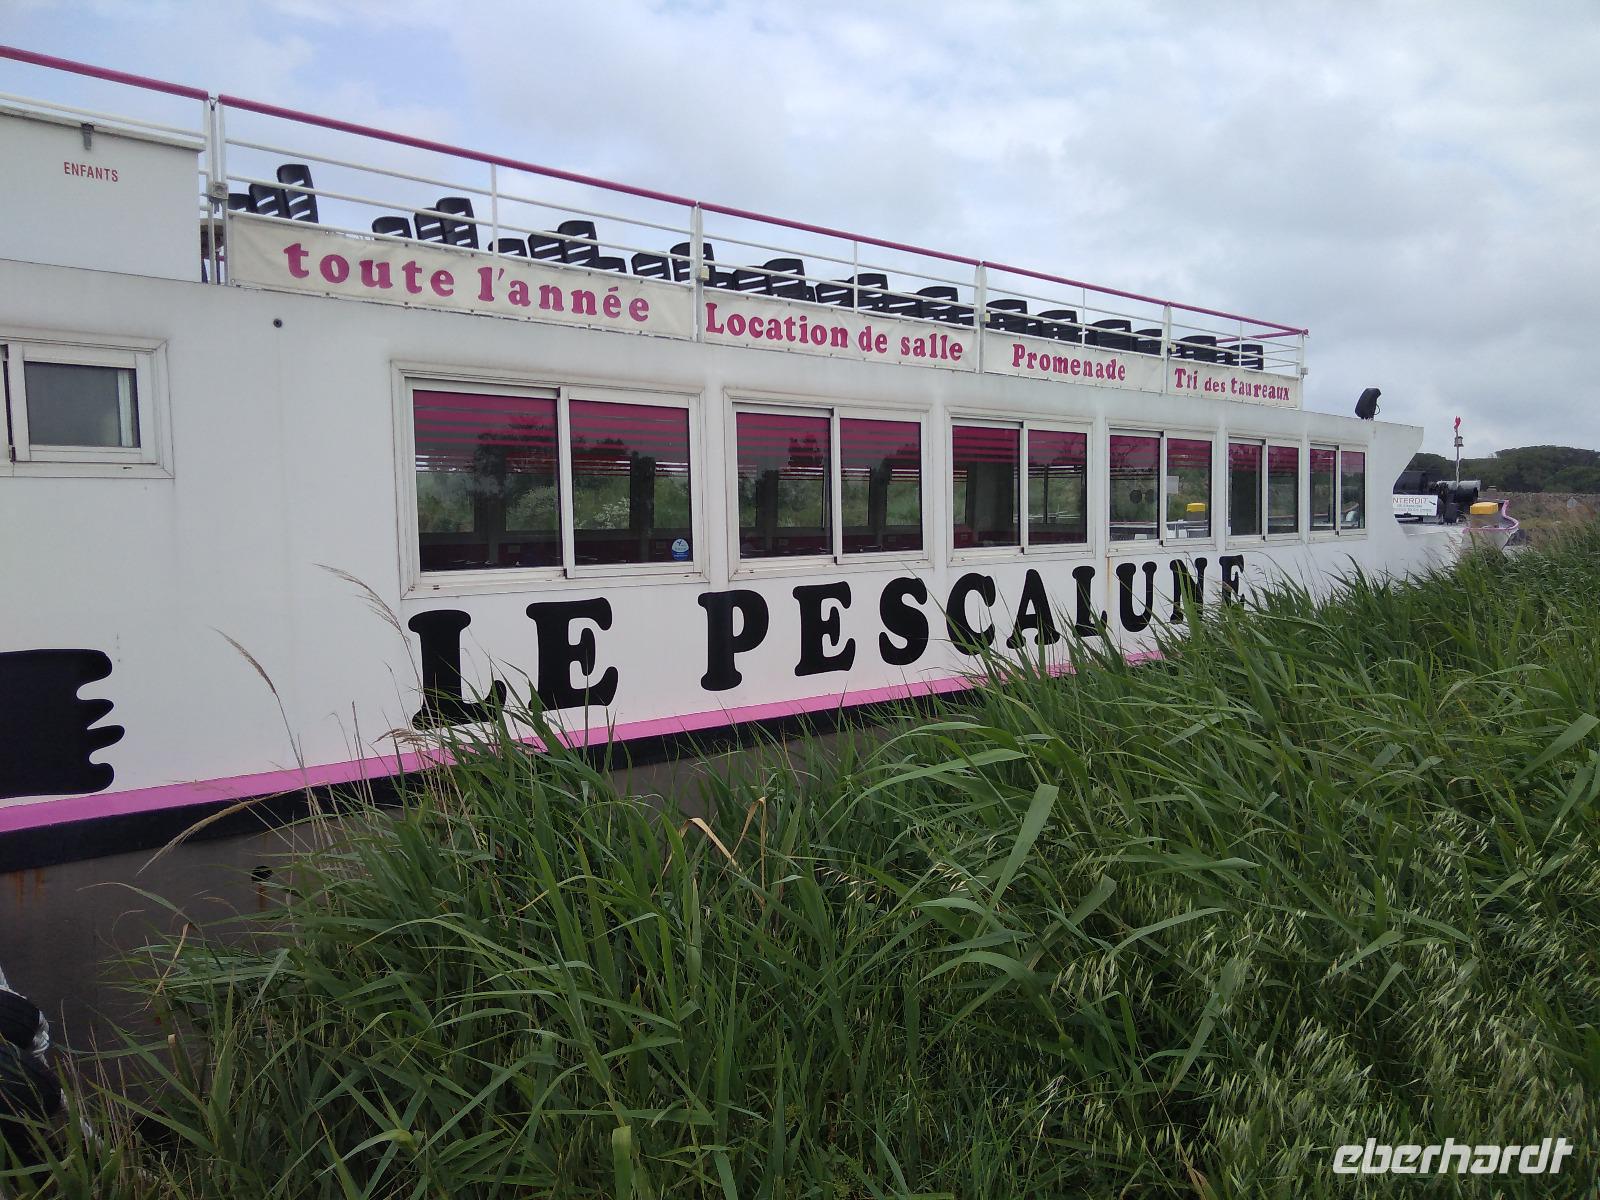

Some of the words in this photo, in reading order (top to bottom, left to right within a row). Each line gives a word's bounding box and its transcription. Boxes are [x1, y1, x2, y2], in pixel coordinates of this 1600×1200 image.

[63, 161, 119, 183] ENFANTS
[283, 242, 455, 297] toute
[477, 266, 650, 322] l'année
[705, 302, 848, 348] Location
[858, 325, 888, 353] de
[900, 333, 963, 361] salle
[1012, 343, 1126, 381] Promenade
[1174, 367, 1198, 390] Tri
[1204, 376, 1226, 392] des
[1230, 377, 1290, 401] taureaux
[1392, 497, 1428, 505] NTERDIT
[408, 597, 618, 730] LE
[697, 554, 1245, 691] PESCALUNE
